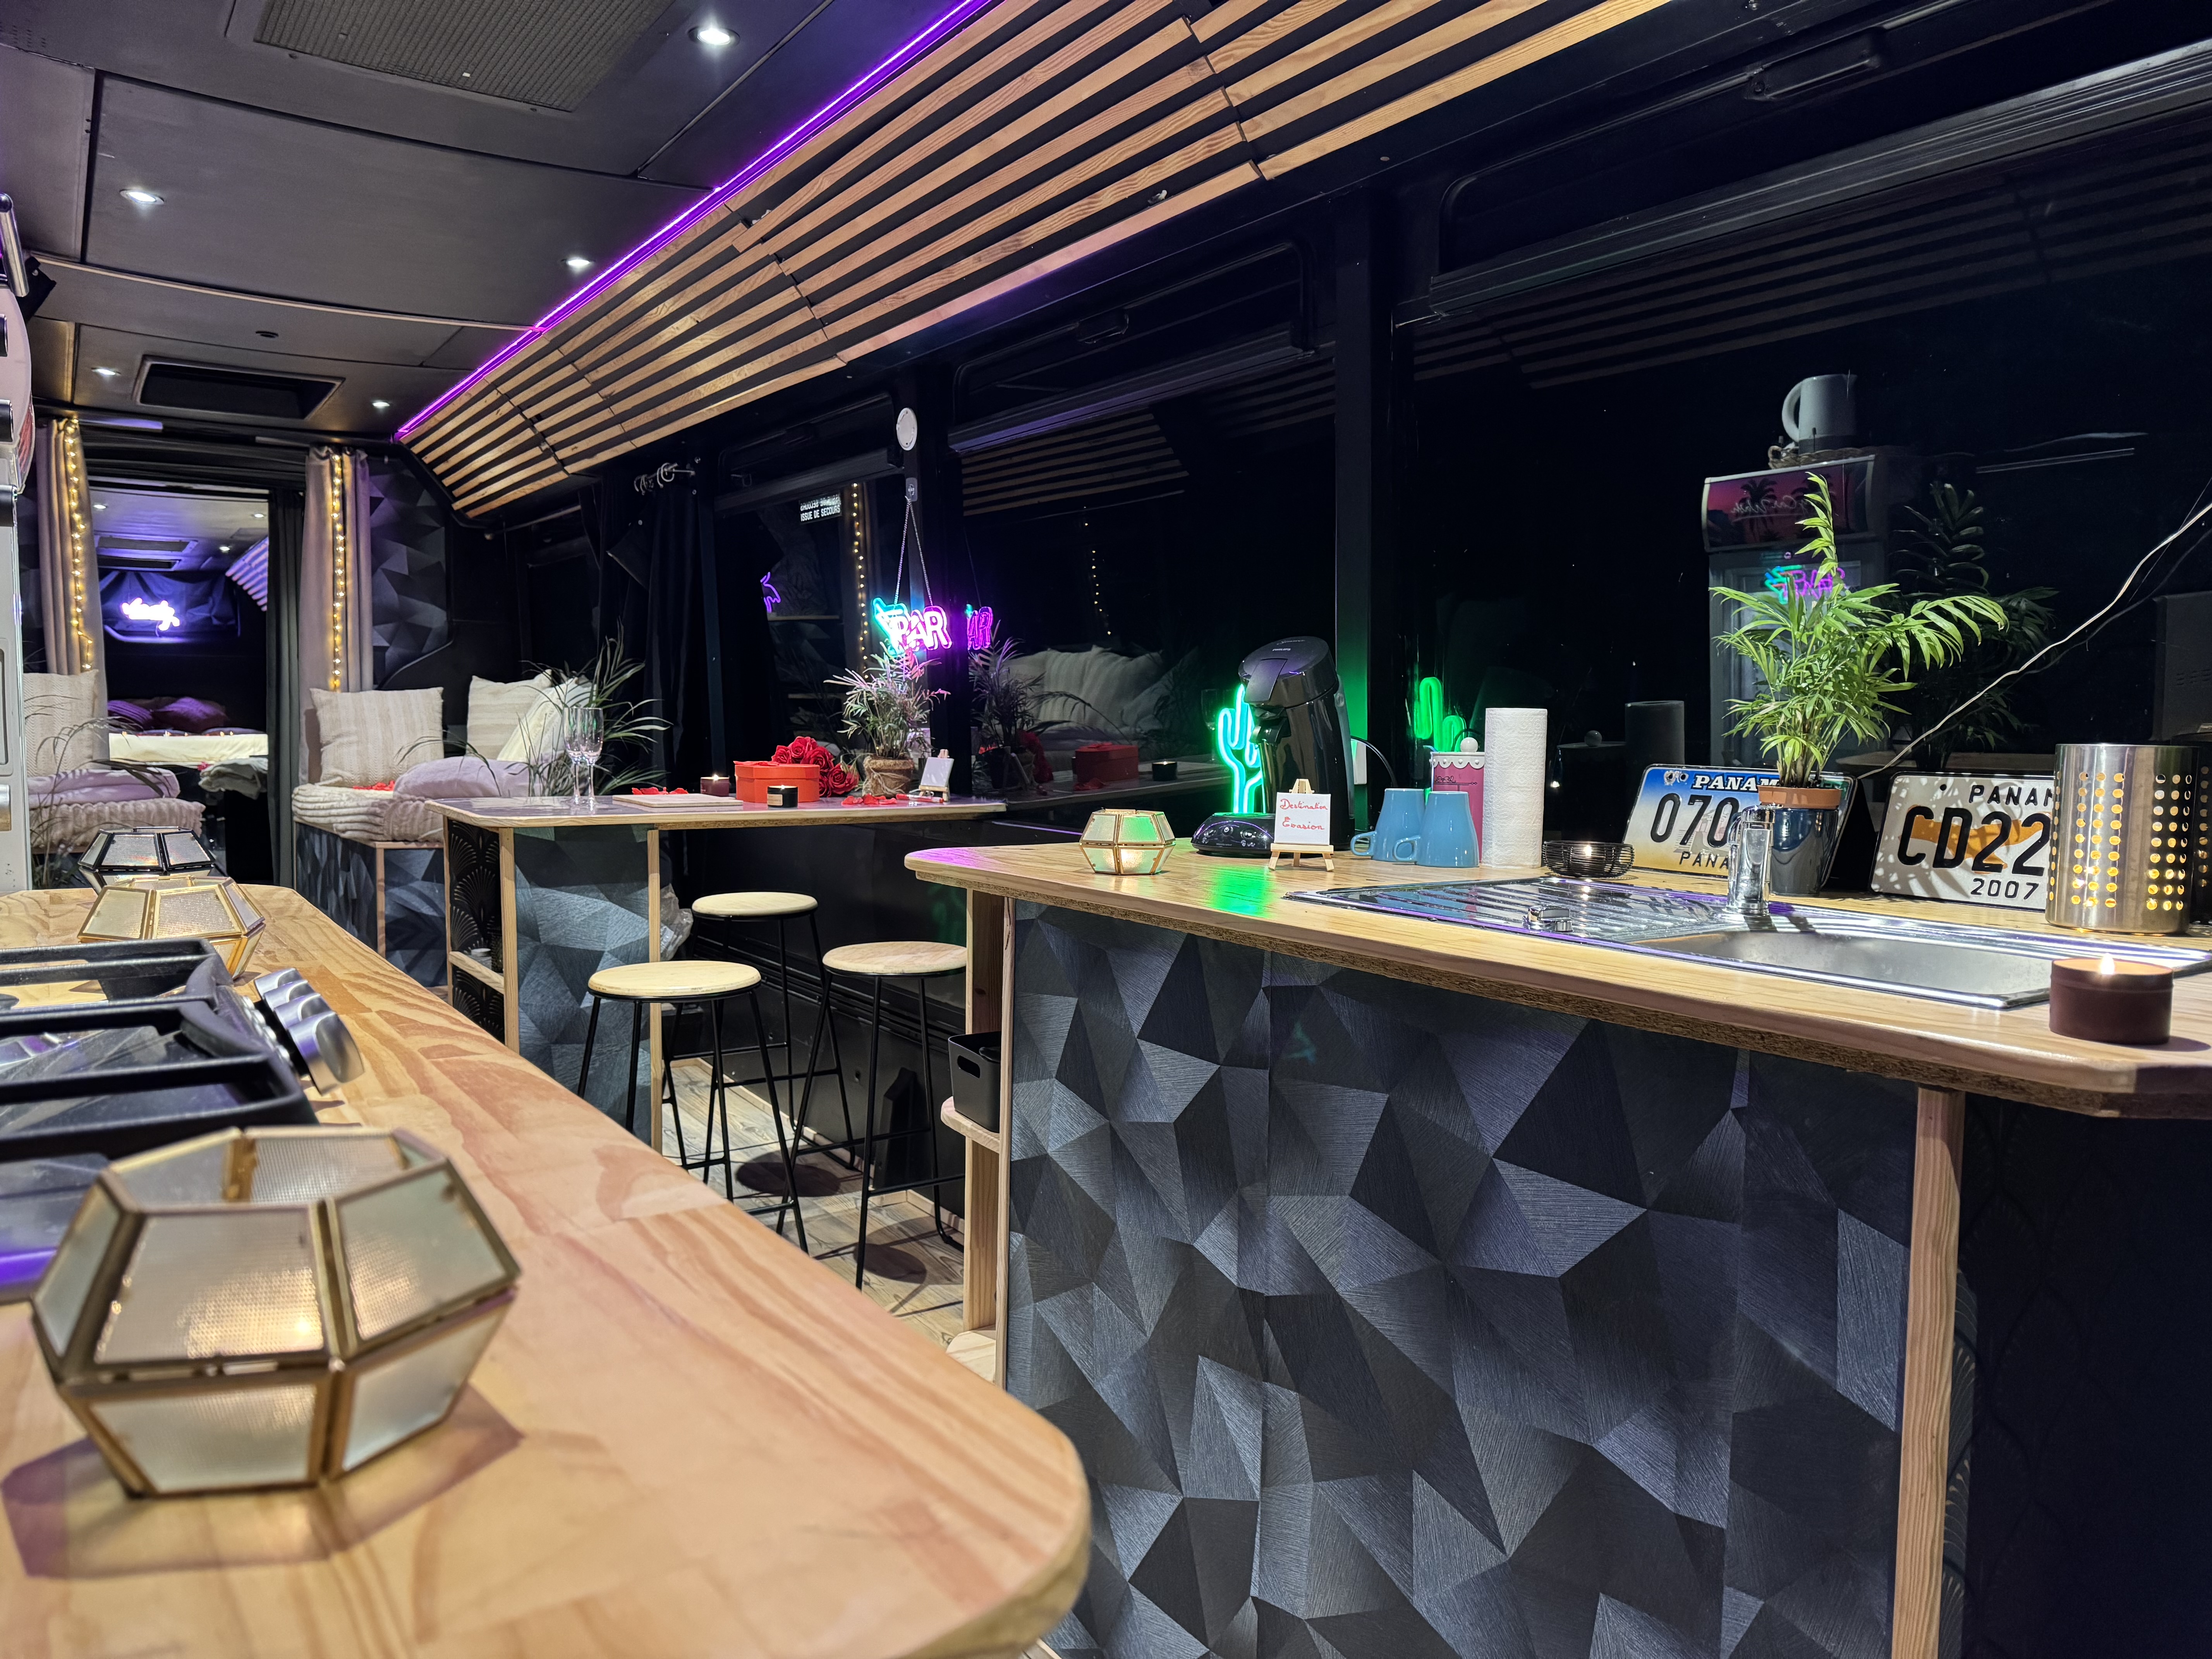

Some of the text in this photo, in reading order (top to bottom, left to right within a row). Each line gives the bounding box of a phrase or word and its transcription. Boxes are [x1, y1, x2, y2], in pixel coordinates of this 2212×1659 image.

[814, 509, 820, 519] DE
[821, 504, 840, 517] SECOURS
[1280, 799, 1328, 810] Destination
[1650, 793, 1740, 847] 070
[1898, 806, 2051, 876] CD22
[1679, 851, 1729, 869] PANA
[1971, 878, 2039, 899] 2007
